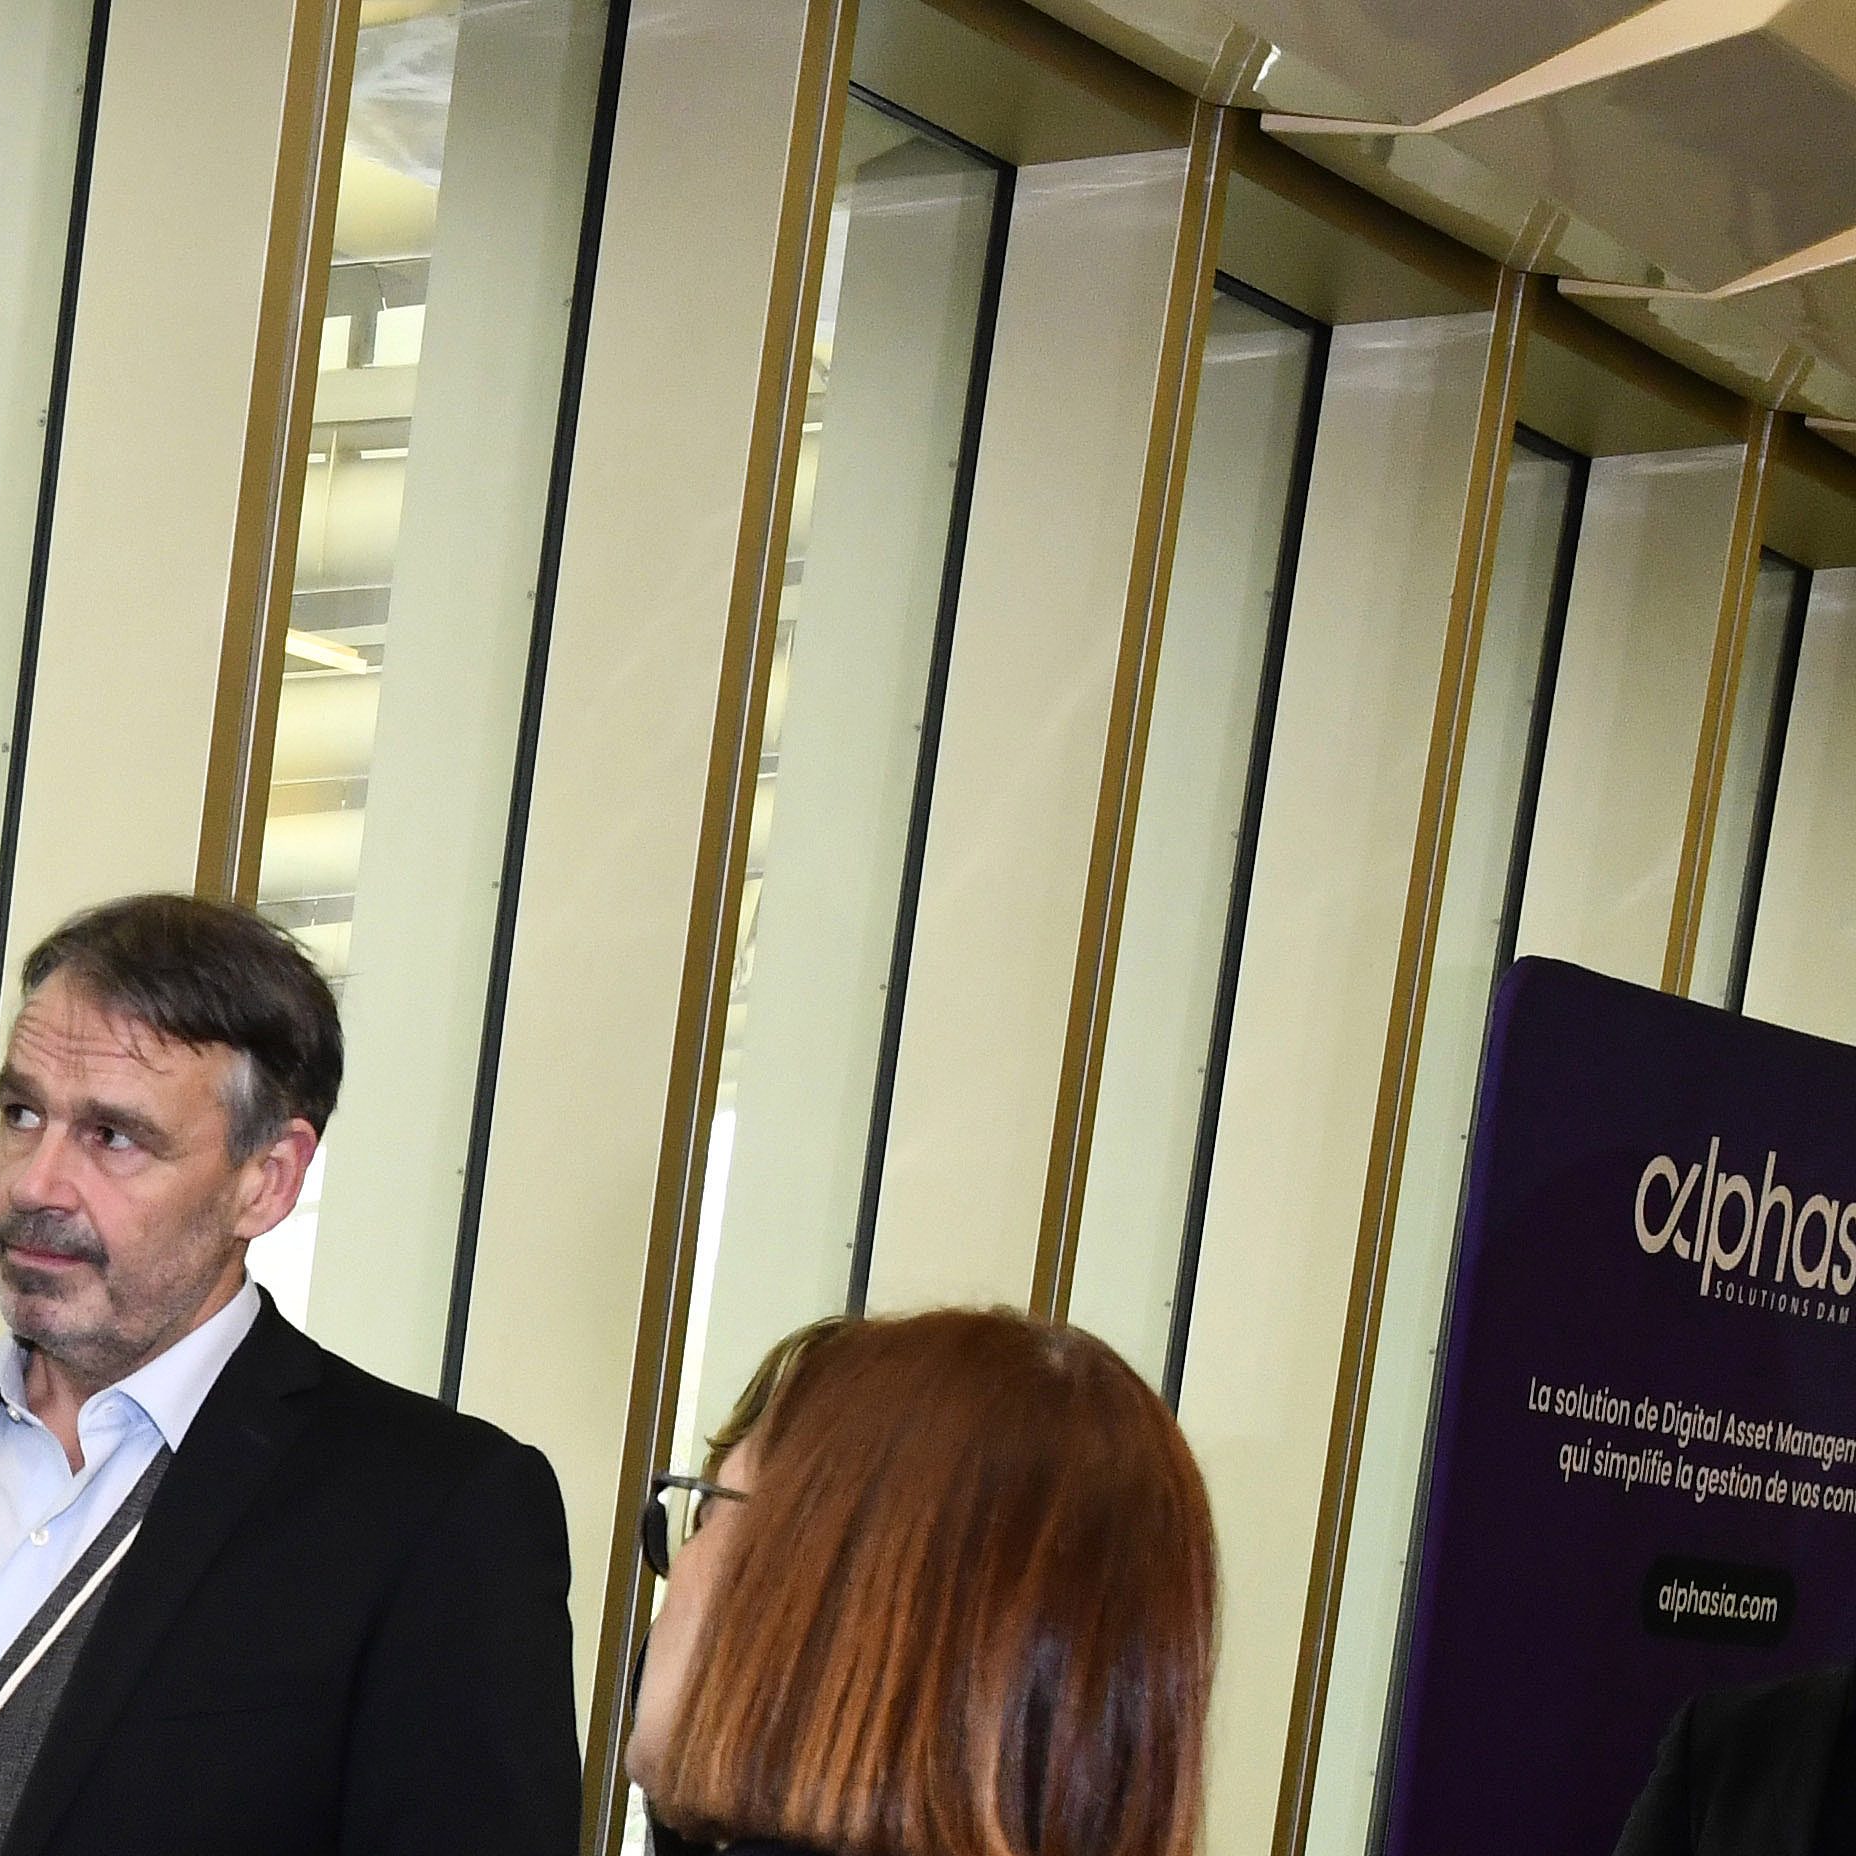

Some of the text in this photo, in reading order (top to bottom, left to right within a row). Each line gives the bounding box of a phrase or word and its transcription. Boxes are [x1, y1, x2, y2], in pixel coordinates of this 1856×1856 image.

[1715, 1280, 1849, 1323] SOLUTIONS DAM
[1529, 1377, 1551, 1412] La
[1555, 1384, 1630, 1426] solution
[1635, 1397, 1658, 1431] de
[1662, 1401, 1722, 1448] Digital
[1723, 1414, 1773, 1450] Asset
[1560, 1438, 1590, 1482] qui
[1593, 1441, 1672, 1492] simplifie
[1675, 1456, 1693, 1489] la
[1695, 1463, 1762, 1503] gestion
[1765, 1471, 1787, 1503] de
[1792, 1481, 1820, 1508] vos
[1659, 1579, 1777, 1622] alphasia.com
